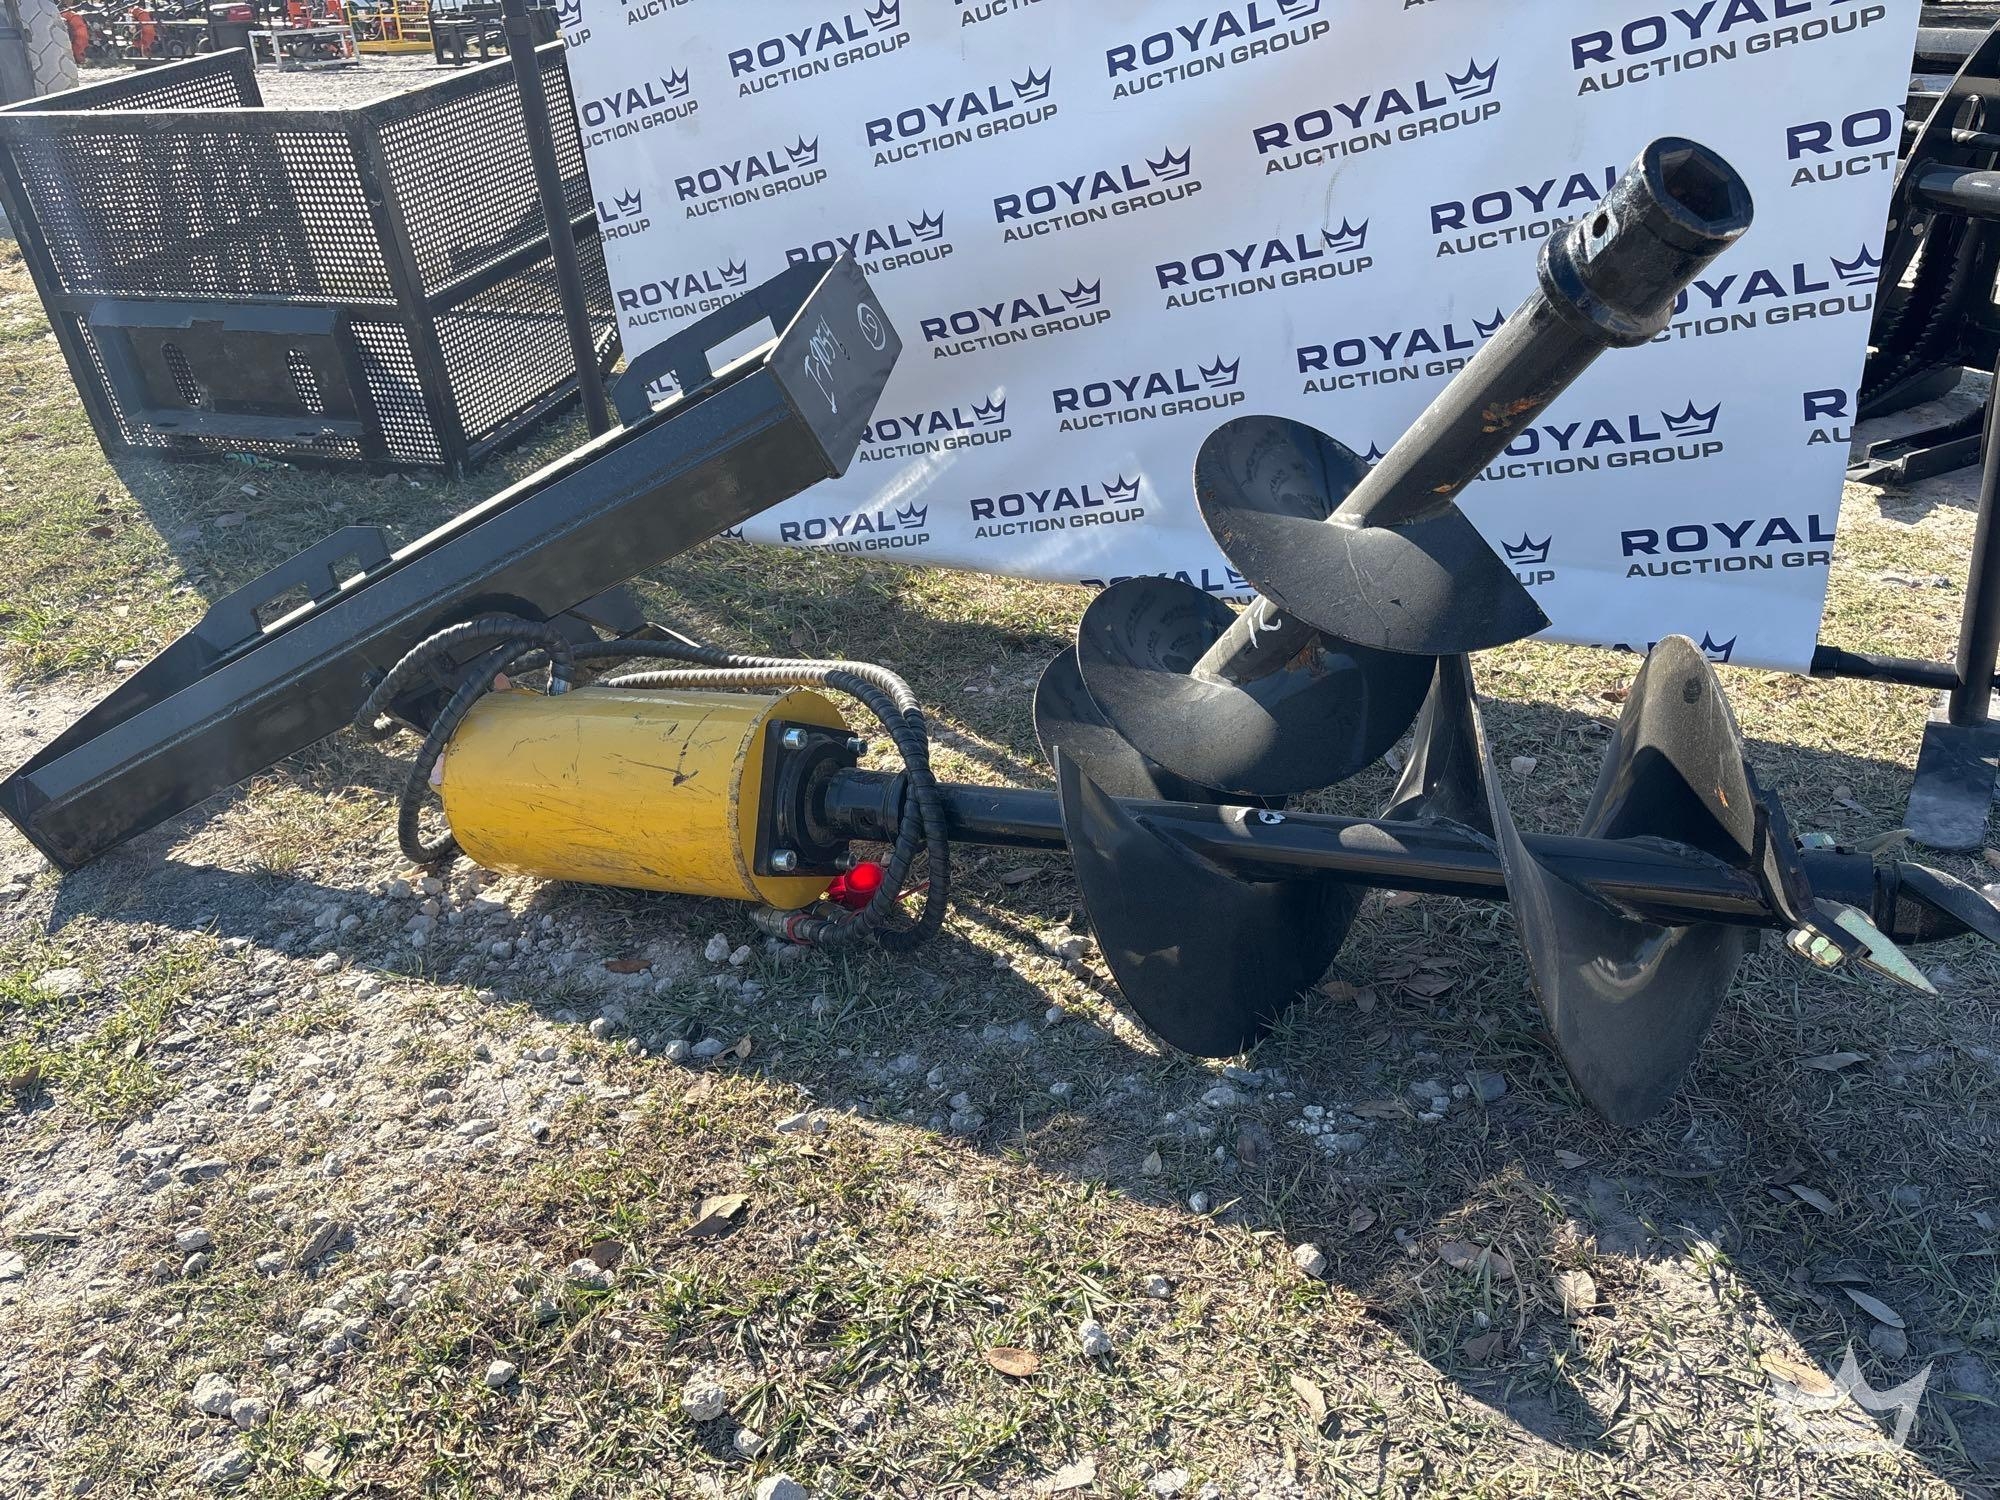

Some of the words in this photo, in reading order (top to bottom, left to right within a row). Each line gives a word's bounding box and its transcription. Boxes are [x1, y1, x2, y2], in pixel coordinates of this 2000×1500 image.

[728, 15, 868, 78] ROYAL
[1106, 2, 1275, 78] ROYAL
[1113, 53, 1225, 100] AUCTION
[1230, 20, 1330, 64] GROUP
[1571, 0, 1811, 70] ROYAL
[1577, 40, 1736, 96] AUCTION
[1745, 5, 1885, 54] GROUP
[739, 58, 829, 98] AUCTION
[834, 32, 911, 68] GROUP
[580, 82, 666, 128] OYAL
[582, 120, 639, 150] UCTION
[642, 100, 699, 130] GROUP
[865, 85, 1014, 147] ROYAL
[1252, 80, 1447, 154] ROYAL
[874, 128, 973, 167] AUCTION
[976, 104, 1057, 139] GROUP
[1265, 130, 1391, 175] AUCTION
[1397, 101, 1500, 141] GROUP
[674, 150, 789, 201] ROYAL
[686, 188, 761, 219] AUCTION
[762, 168, 827, 199] GROUP
[993, 164, 1150, 223] ROYAL
[1790, 151, 1896, 187] AUCT
[1003, 206, 1108, 243] AUCTION
[1111, 180, 1202, 216] GROUP
[881, 243, 953, 271] GROUP
[1155, 233, 1324, 289] ROYAL
[617, 270, 722, 311] ROYAL
[1166, 275, 1276, 310] AUCTION
[1281, 256, 1373, 287] GROUP
[1673, 262, 1829, 315] YAL
[628, 302, 697, 328] AUCTION
[920, 293, 1065, 342] ROYAL
[933, 328, 1028, 359] AUCTION
[1031, 309, 1111, 337] GROUP
[1650, 311, 1756, 343] CTION
[1765, 293, 1873, 325] GROU
[1296, 323, 1474, 373] ROYAL
[1053, 368, 1200, 414] ROYAL
[1303, 365, 1420, 394] AUCTION
[1059, 405, 1157, 432] AUCTION
[1161, 391, 1245, 416] GROUP
[1499, 414, 1661, 457] OYAL
[859, 440, 940, 463] AUCTION
[944, 429, 1012, 450] GROUP
[1606, 441, 1724, 468] GROUP
[780, 511, 895, 542] ROYAL
[970, 484, 1104, 520] ROYAL
[975, 517, 1065, 538] AUCTION
[1069, 507, 1145, 528] GROUP
[865, 533, 930, 550] GROUP
[1621, 514, 1836, 556] ROYAL
[1626, 554, 1773, 578] AUCTION
